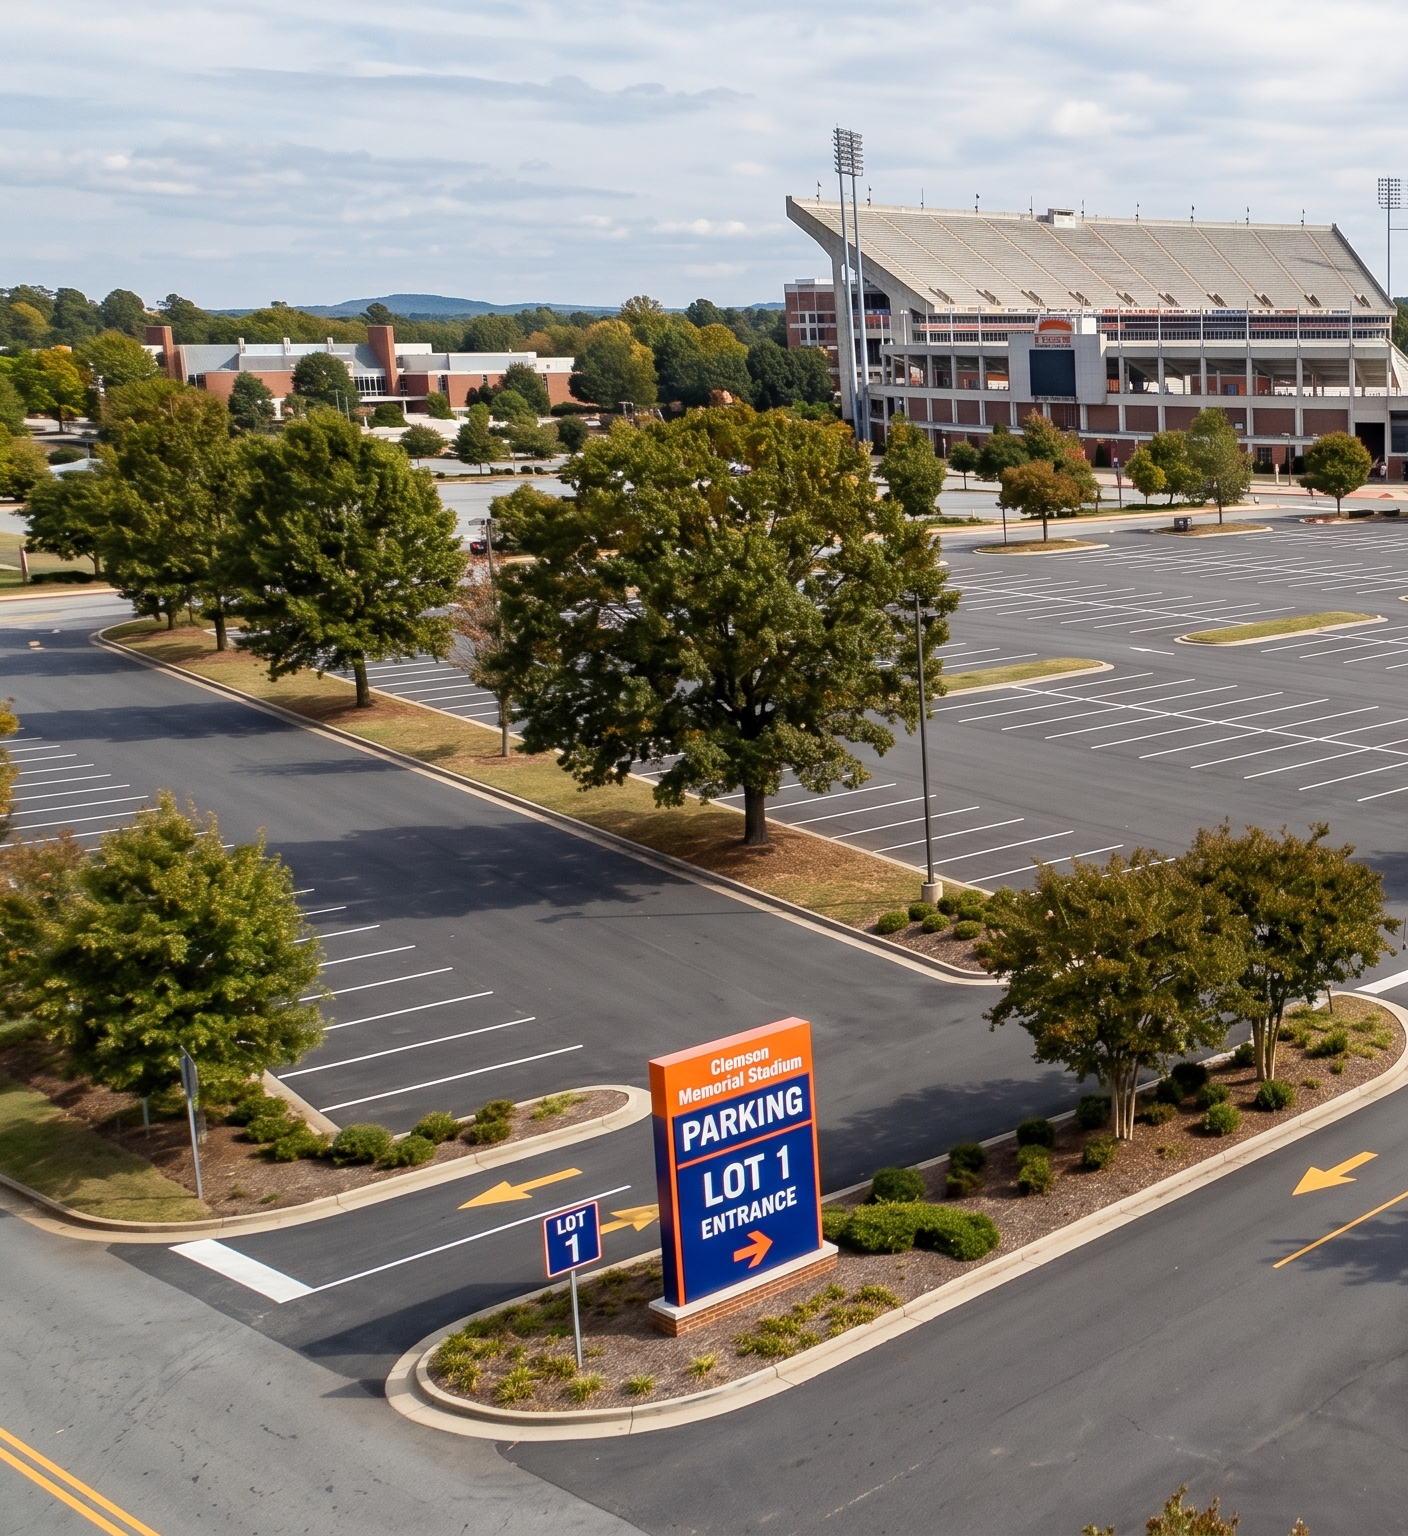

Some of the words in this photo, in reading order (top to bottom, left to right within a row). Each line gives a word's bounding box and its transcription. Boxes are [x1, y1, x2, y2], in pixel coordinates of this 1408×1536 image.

[678, 1071, 744, 1106] Memorial
[748, 1056, 803, 1083] Stadium
[711, 1047, 769, 1076] Clemson
[682, 1086, 803, 1152] PARKING
[703, 1153, 765, 1208] LOT
[776, 1144, 789, 1180] 1
[556, 1210, 586, 1235] LOT
[701, 1186, 797, 1240] ENTRANCE
[565, 1233, 580, 1263] 1
